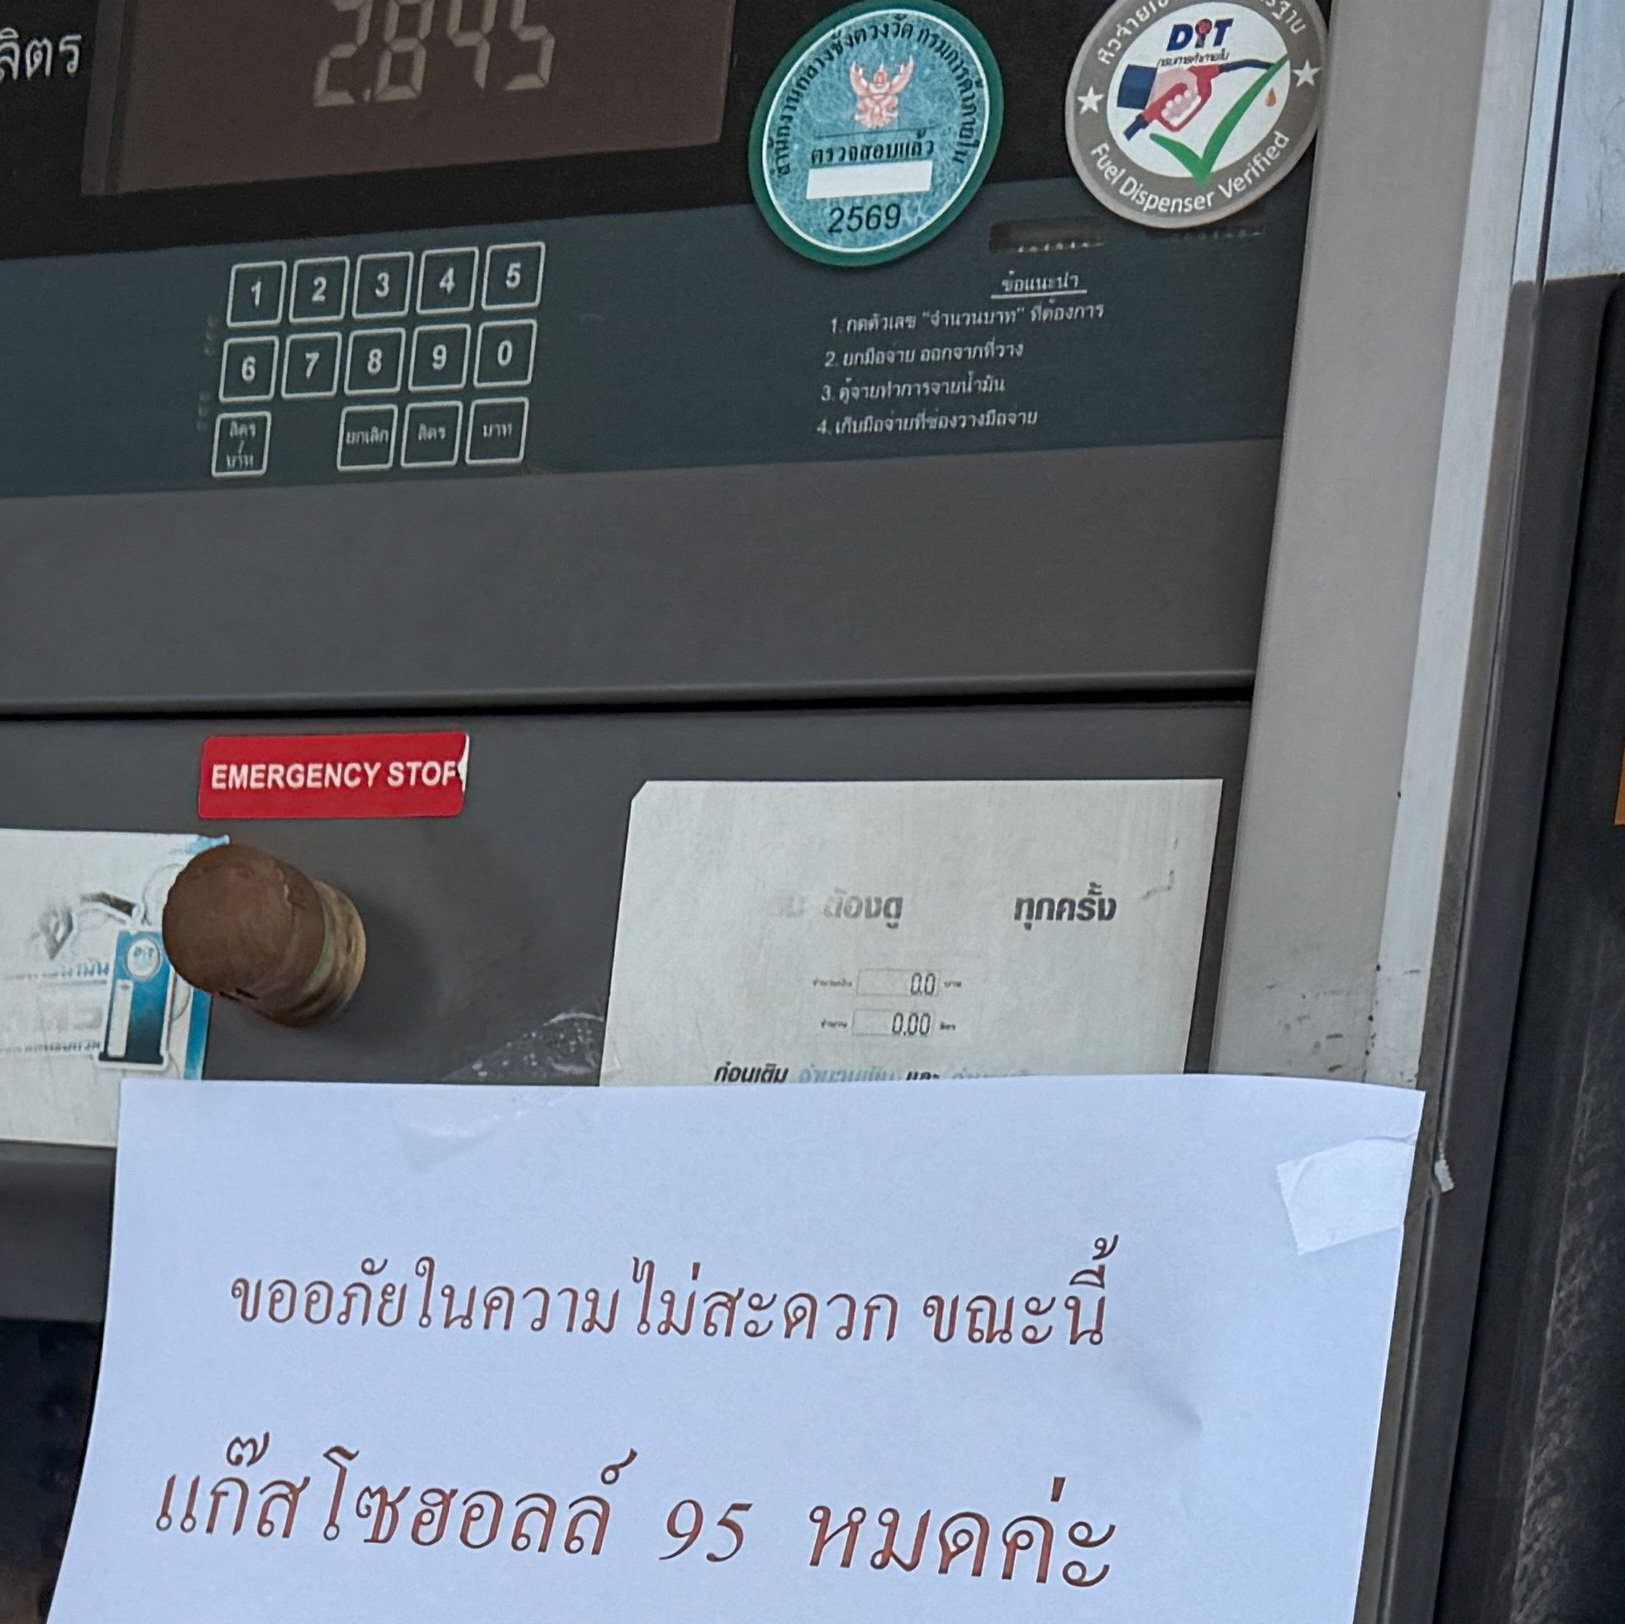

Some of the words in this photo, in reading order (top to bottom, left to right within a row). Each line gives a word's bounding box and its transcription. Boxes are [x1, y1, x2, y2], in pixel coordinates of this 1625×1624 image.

[810, 129, 935, 165] ตรวจสอบแล้ว
[1090, 142, 1121, 185] Fuel
[1119, 177, 1216, 214] Dispenser
[1218, 131, 1291, 200] Verified
[828, 203, 901, 234] 2569
[250, 280, 263, 308] 1
[312, 276, 327, 302] 2
[375, 272, 390, 298] 3
[438, 267, 456, 294] 4
[505, 262, 522, 289] 5
[1001, 270, 1080, 294] ข้อแนะนำ
[241, 356, 257, 382] 6
[304, 352, 320, 378] 7
[367, 349, 383, 375] 8
[432, 345, 448, 370] 9
[497, 340, 513, 368] 0
[210, 761, 382, 790] EMERGENCY
[1013, 881, 1117, 931] ทุกครั้ง
[892, 1012, 931, 1037] 0.00
[713, 1061, 789, 1084] ก่อนเติม
[230, 1255, 899, 1346] ขออภัยในความไม่สะดวก
[921, 1234, 1119, 1347] ขณะนี้
[154, 1432, 638, 1557] แก๊สโซฮอลล์
[658, 1494, 754, 1564] 95
[808, 1476, 1117, 1588] หมดค่ะ
